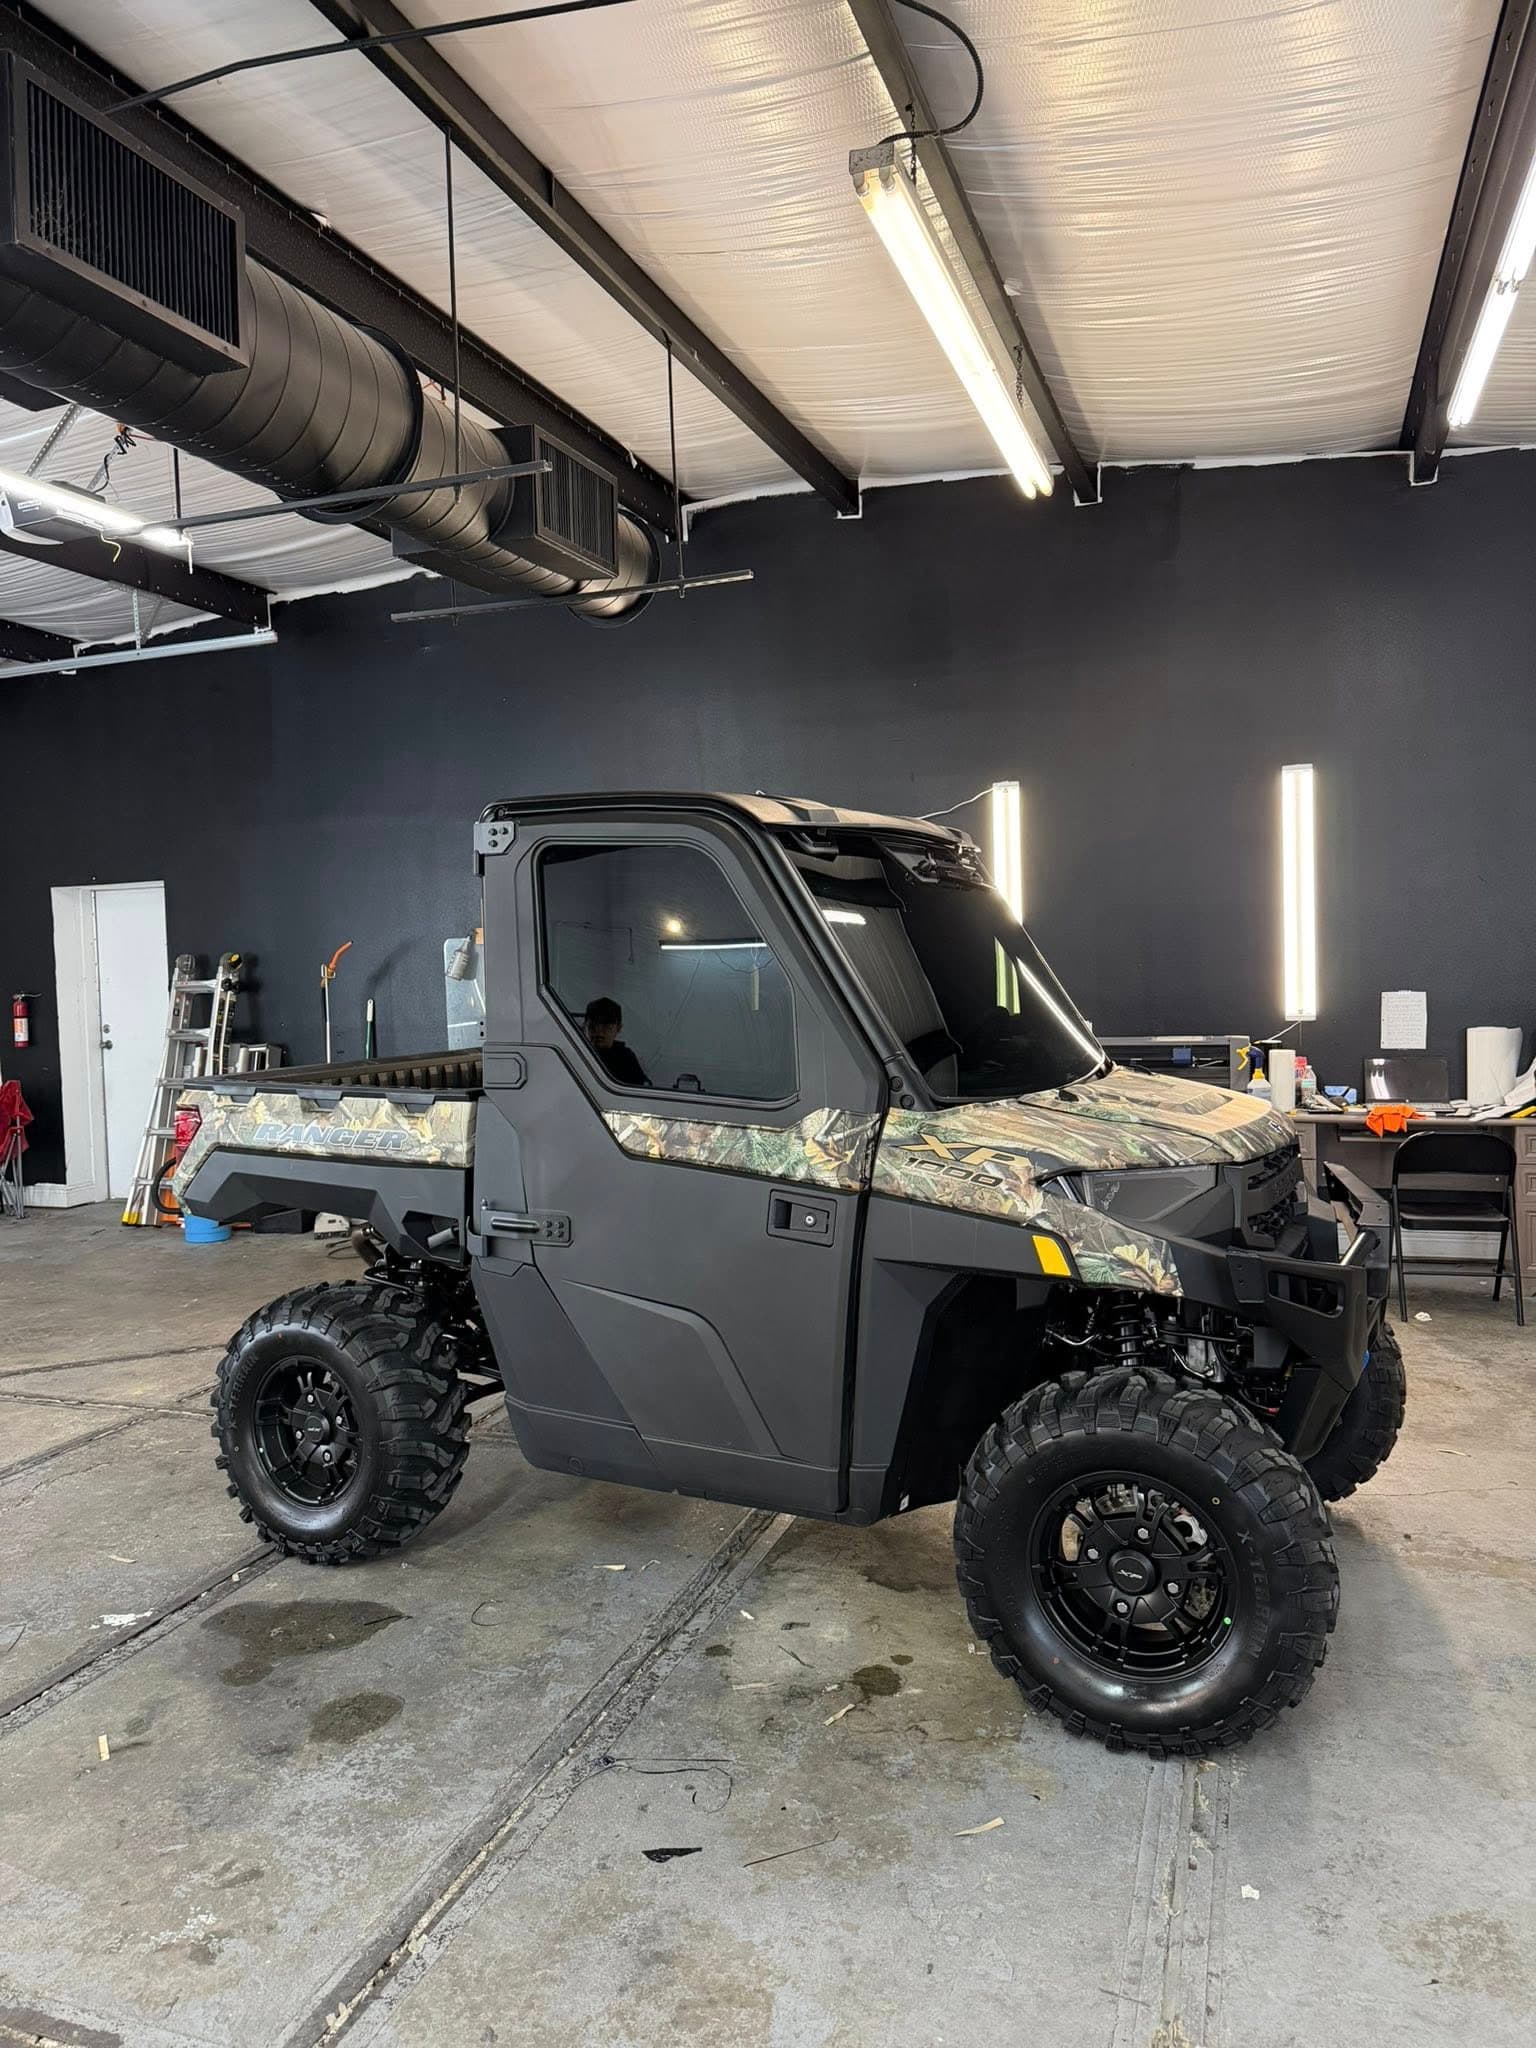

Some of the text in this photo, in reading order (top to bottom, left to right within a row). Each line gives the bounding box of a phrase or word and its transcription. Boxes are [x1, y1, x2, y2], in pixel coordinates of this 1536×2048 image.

[252, 1121, 410, 1152] RANGER
[898, 1132, 1033, 1168] XP
[903, 1156, 1005, 1188] 1000
